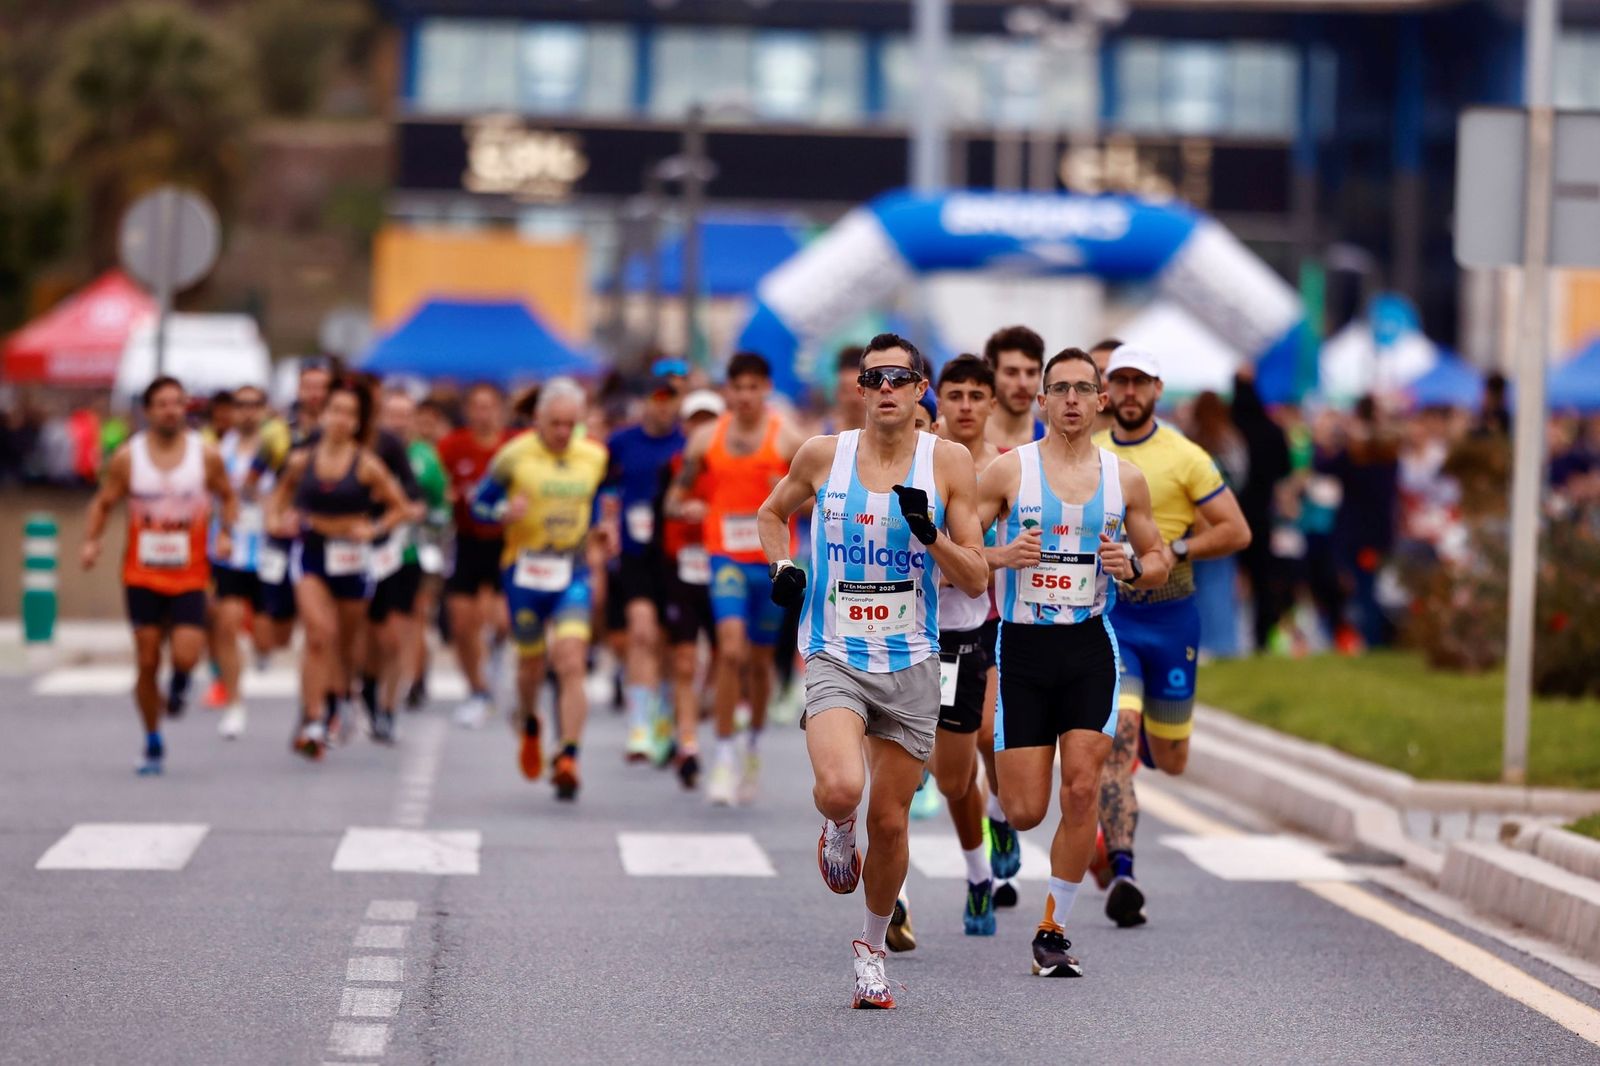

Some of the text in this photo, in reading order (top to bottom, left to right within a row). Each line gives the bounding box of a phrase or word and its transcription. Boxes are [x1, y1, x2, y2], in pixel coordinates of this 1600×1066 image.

[827, 491, 847, 499] vive
[1020, 505, 1041, 513] vive
[1031, 573, 1072, 590] 556
[849, 605, 889, 621] 810
